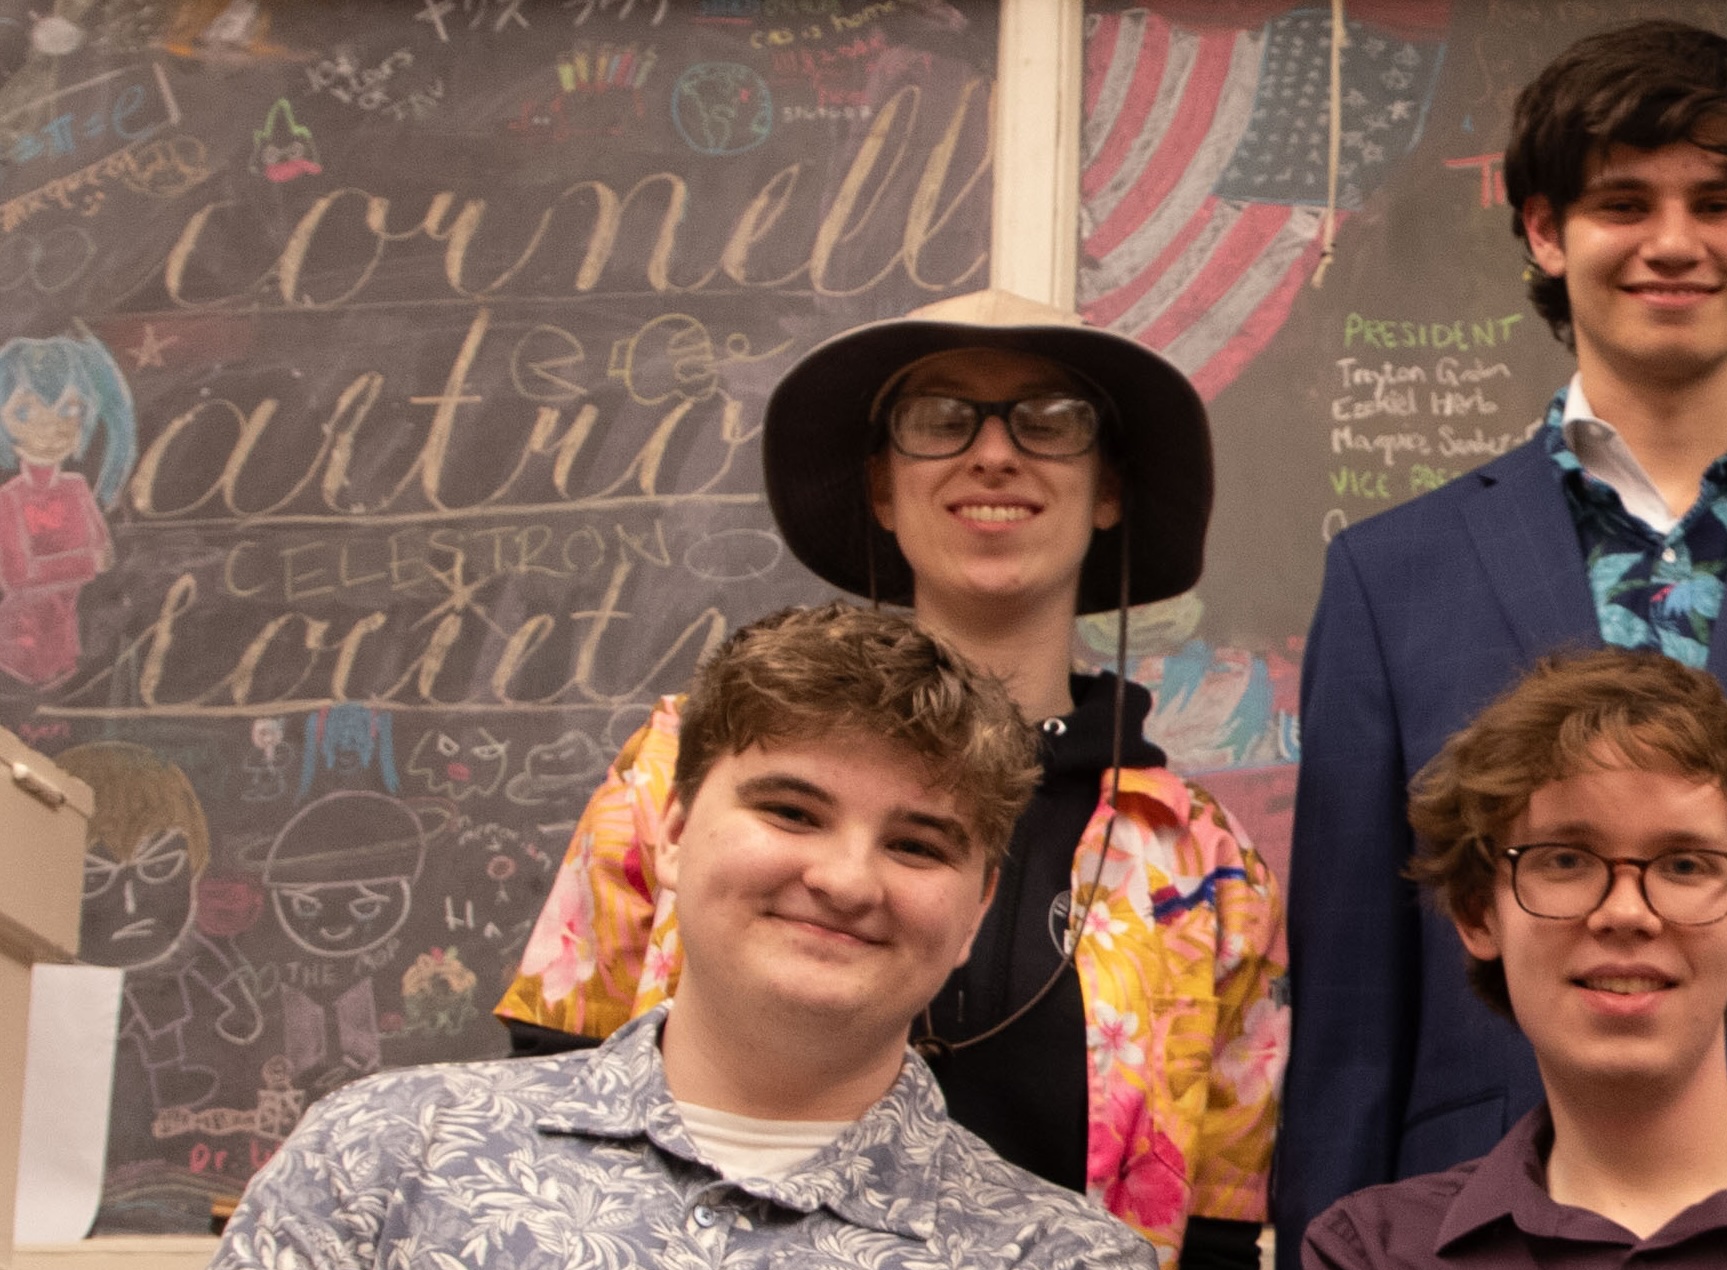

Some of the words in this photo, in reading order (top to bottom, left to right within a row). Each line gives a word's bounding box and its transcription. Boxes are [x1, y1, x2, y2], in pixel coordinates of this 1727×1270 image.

[163, 76, 1000, 309] cornell
[1343, 311, 1525, 351] PRESIDENT
[1329, 466, 1392, 499] VICE
[225, 521, 671, 600] CELESTRON
